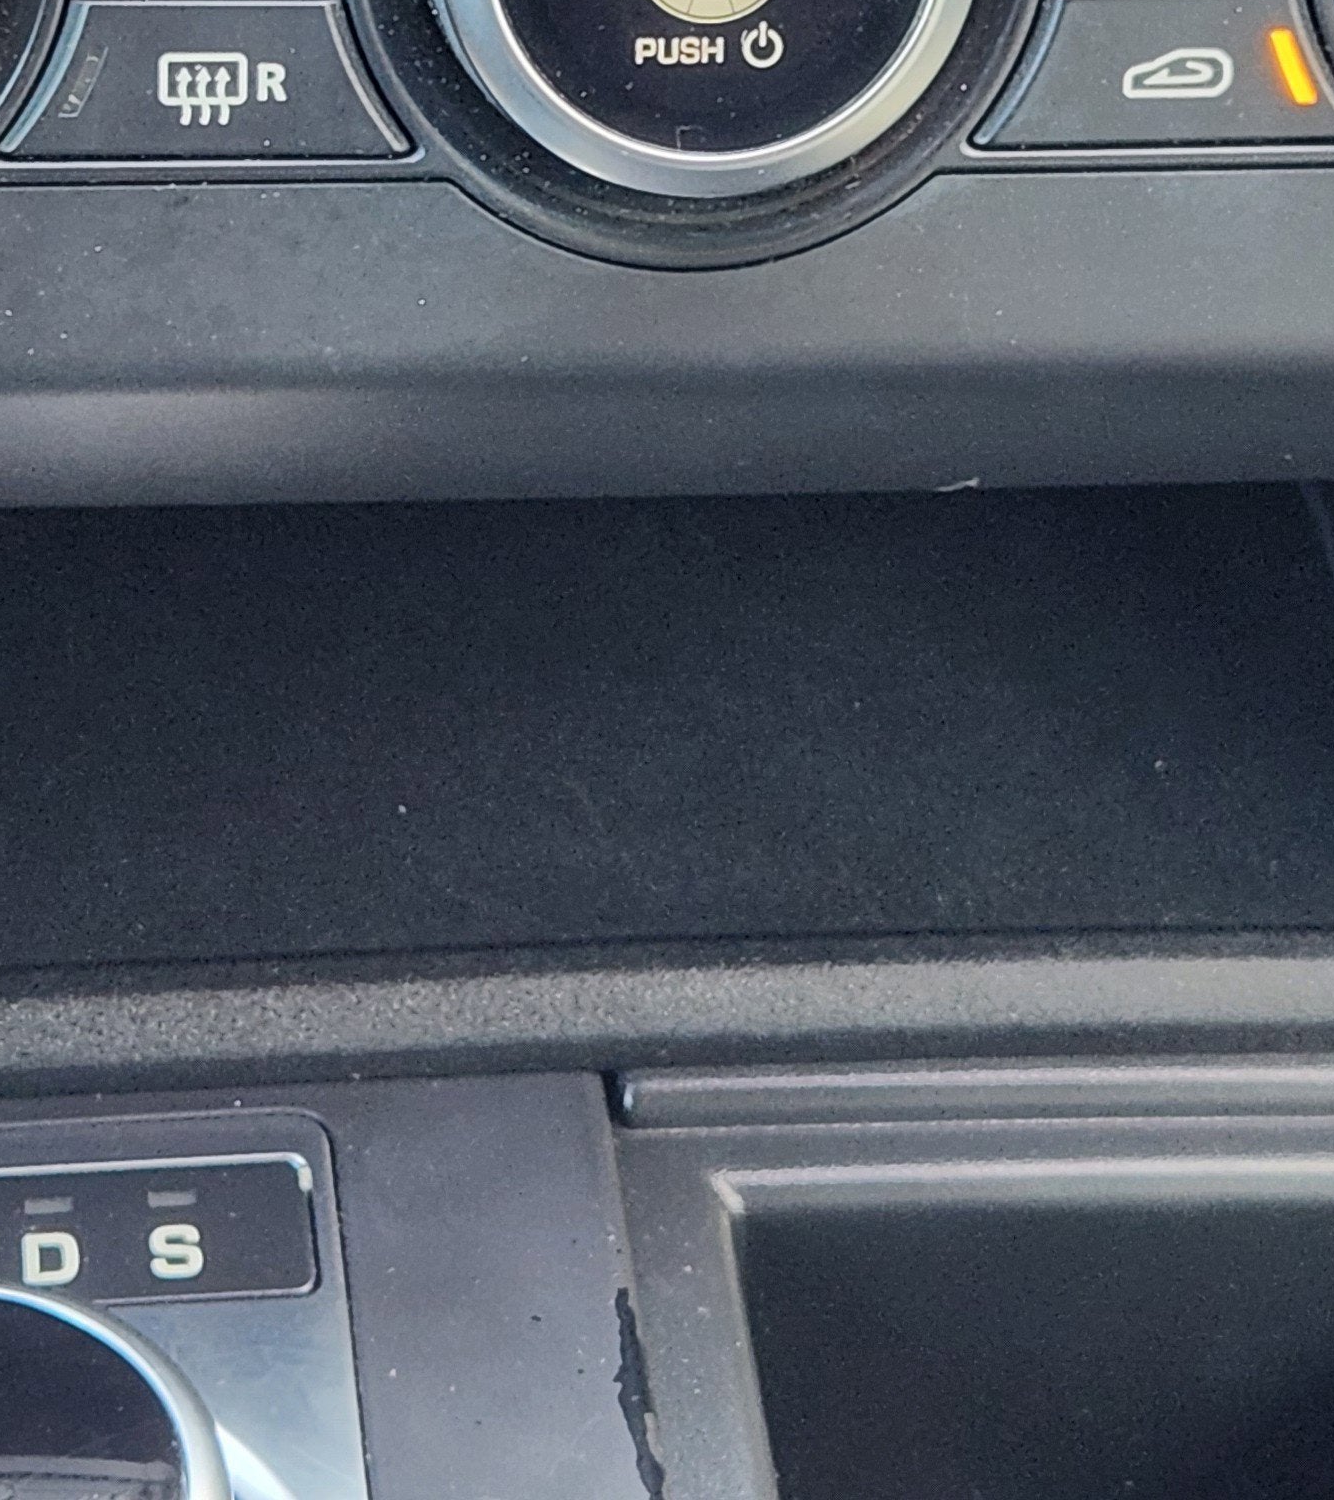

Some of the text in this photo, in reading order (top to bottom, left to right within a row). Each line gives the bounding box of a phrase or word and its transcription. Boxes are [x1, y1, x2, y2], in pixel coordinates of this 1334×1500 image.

[634, 36, 725, 65] PUSH
[256, 63, 287, 102] R
[21, 1231, 80, 1286] D
[149, 1224, 204, 1278] S
